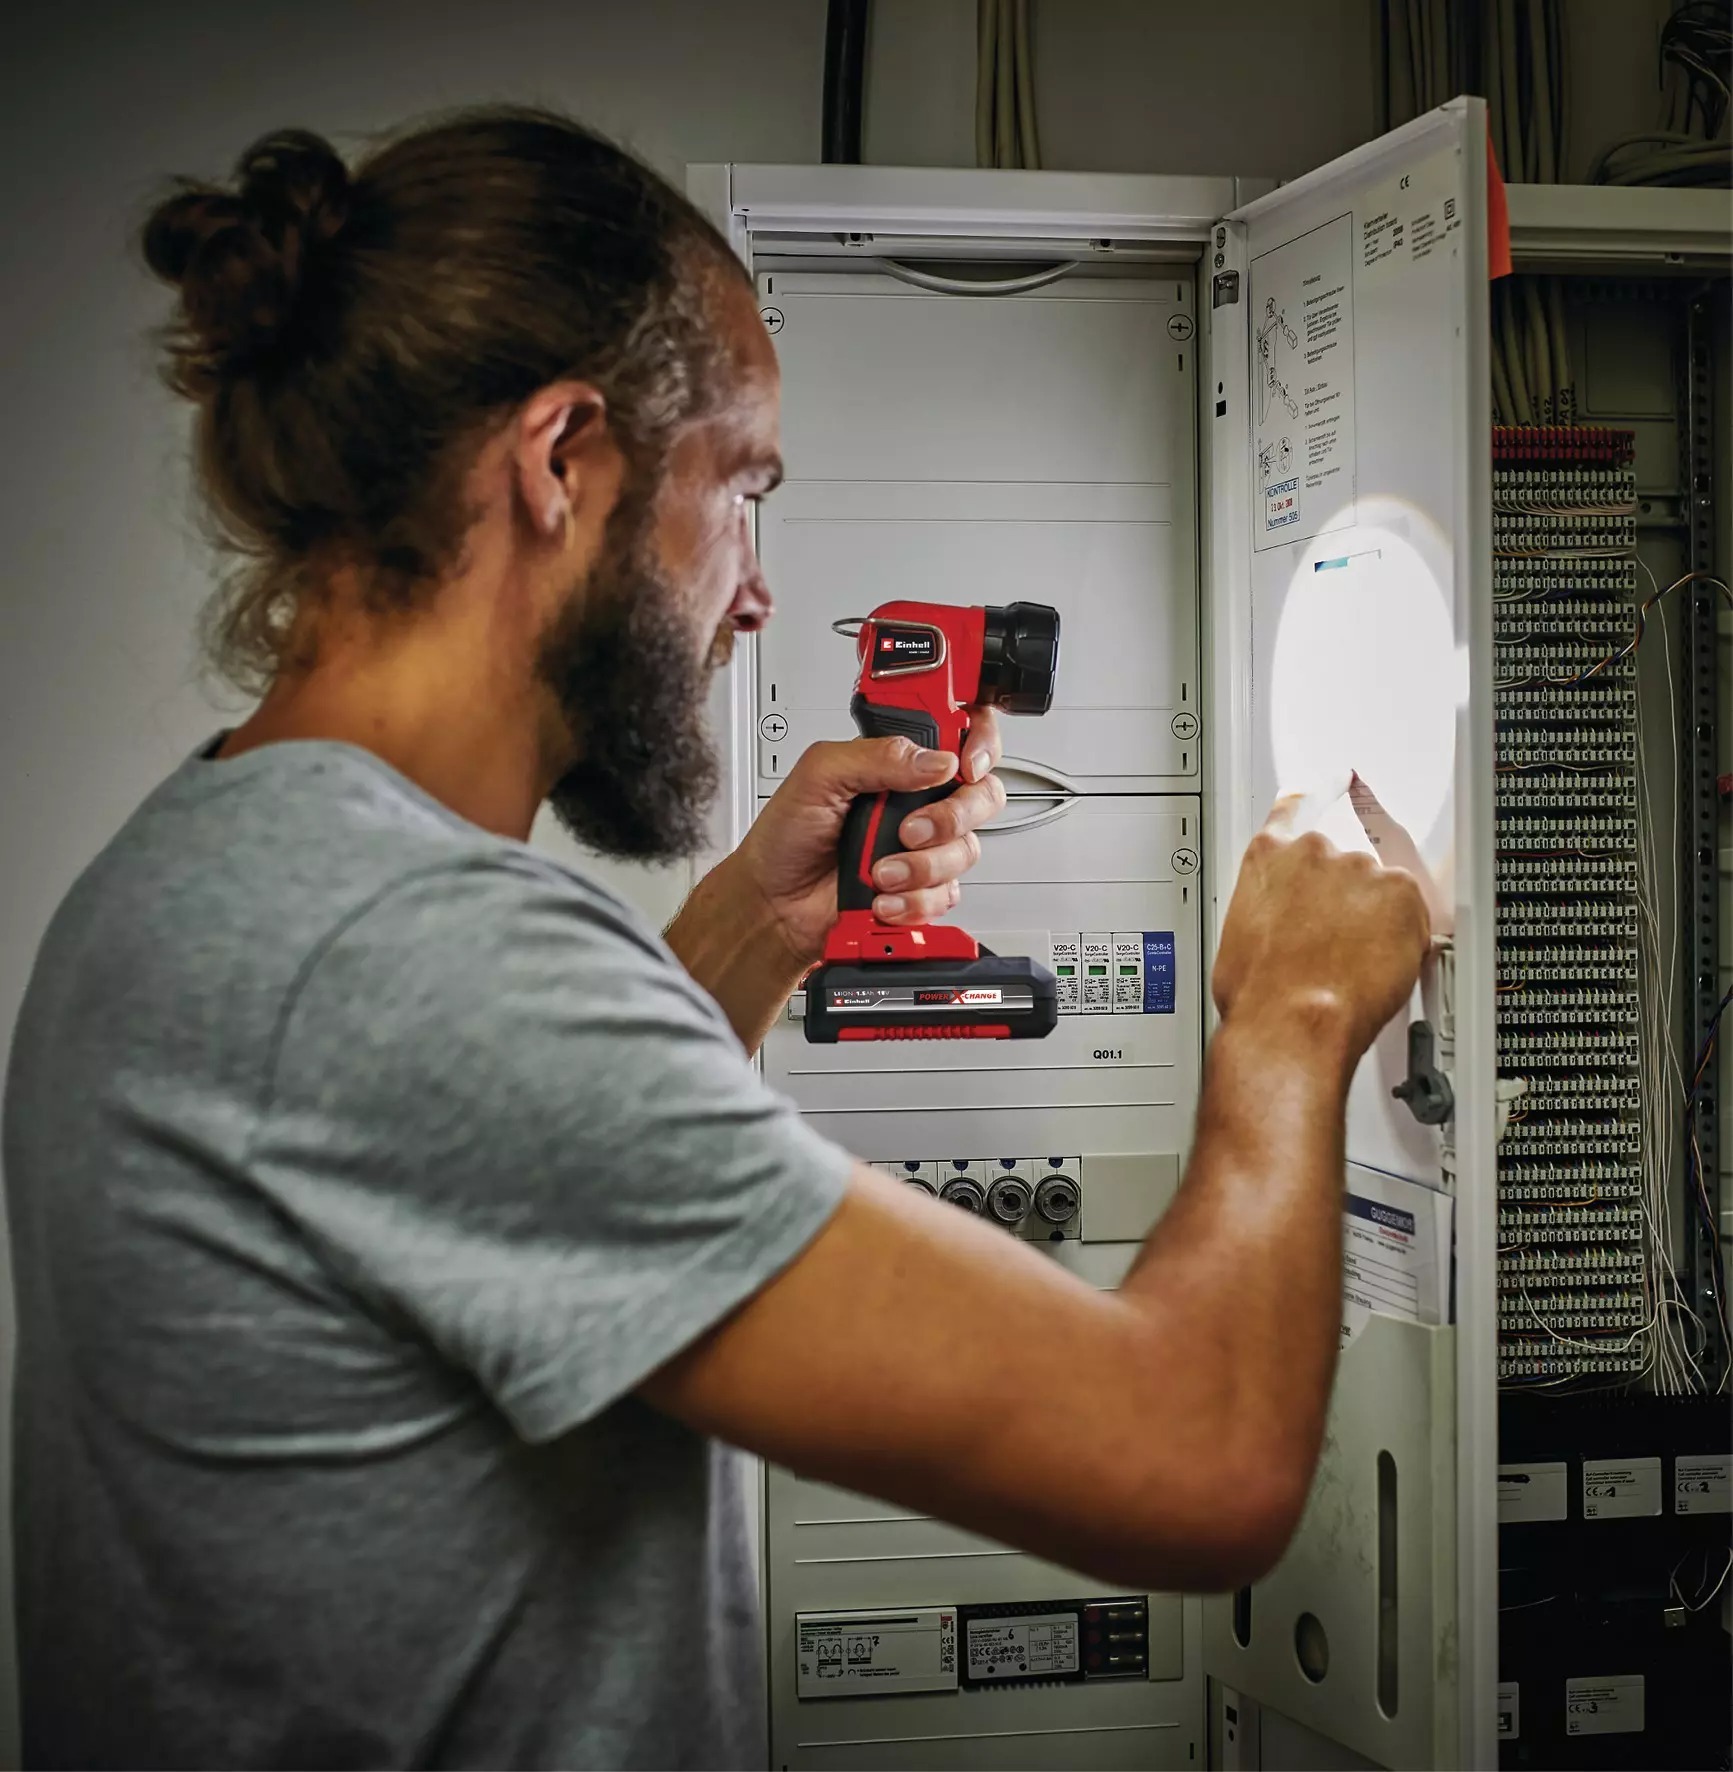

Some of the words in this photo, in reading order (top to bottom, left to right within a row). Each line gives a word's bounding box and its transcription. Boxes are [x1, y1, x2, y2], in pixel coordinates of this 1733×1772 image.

[1267, 480, 1297, 497] KONTROLLE
[1268, 516, 1288, 527] Nummer
[1053, 944, 1077, 952] V20-C
[1146, 943, 1172, 951] C25-B+C
[919, 993, 949, 1001] POWER
[1093, 1050, 1122, 1059] Q01.1
[1586, 1487, 1598, 1497] CE
[1008, 1628, 1015, 1640] 6
[979, 1647, 991, 1656] CE
[1589, 1701, 1598, 1713] 3
